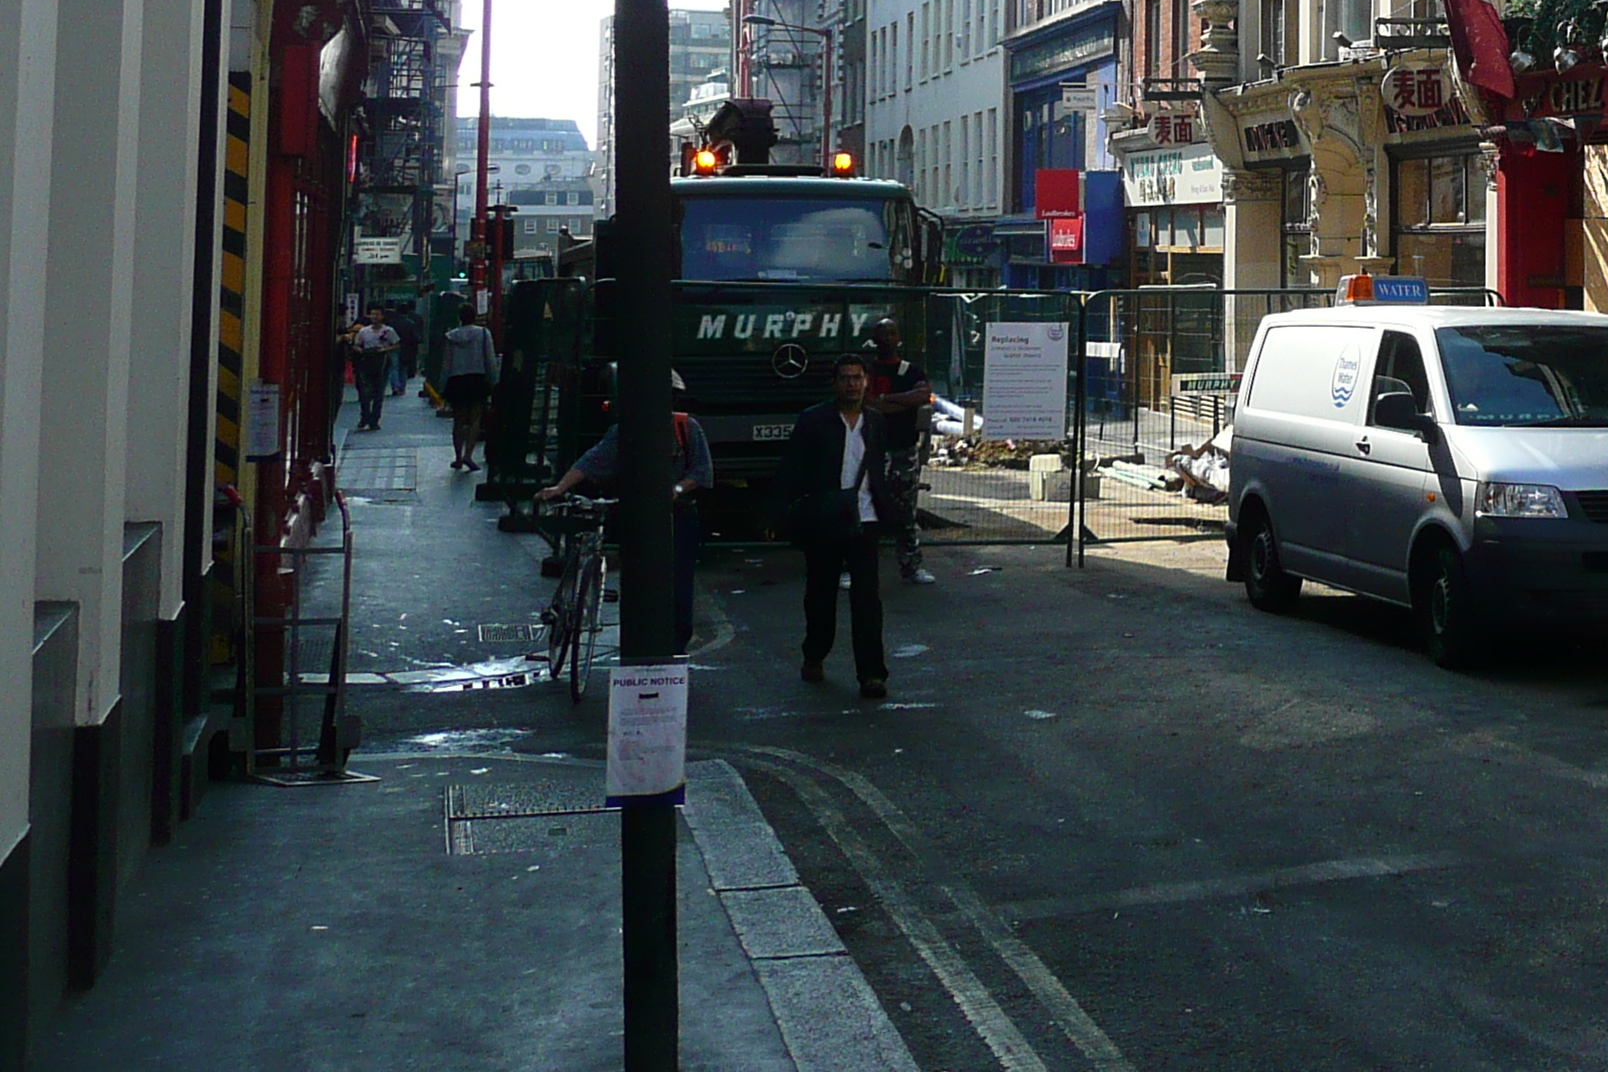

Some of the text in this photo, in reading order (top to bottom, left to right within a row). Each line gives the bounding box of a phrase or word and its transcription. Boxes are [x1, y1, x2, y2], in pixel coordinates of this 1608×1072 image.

[1549, 75, 1602, 112] CHEZ
[1377, 282, 1422, 298] WATER
[696, 312, 868, 339] MURPHY
[1187, 379, 1236, 389] MURPHY
[613, 676, 686, 687] PUBLIC NOTICE
